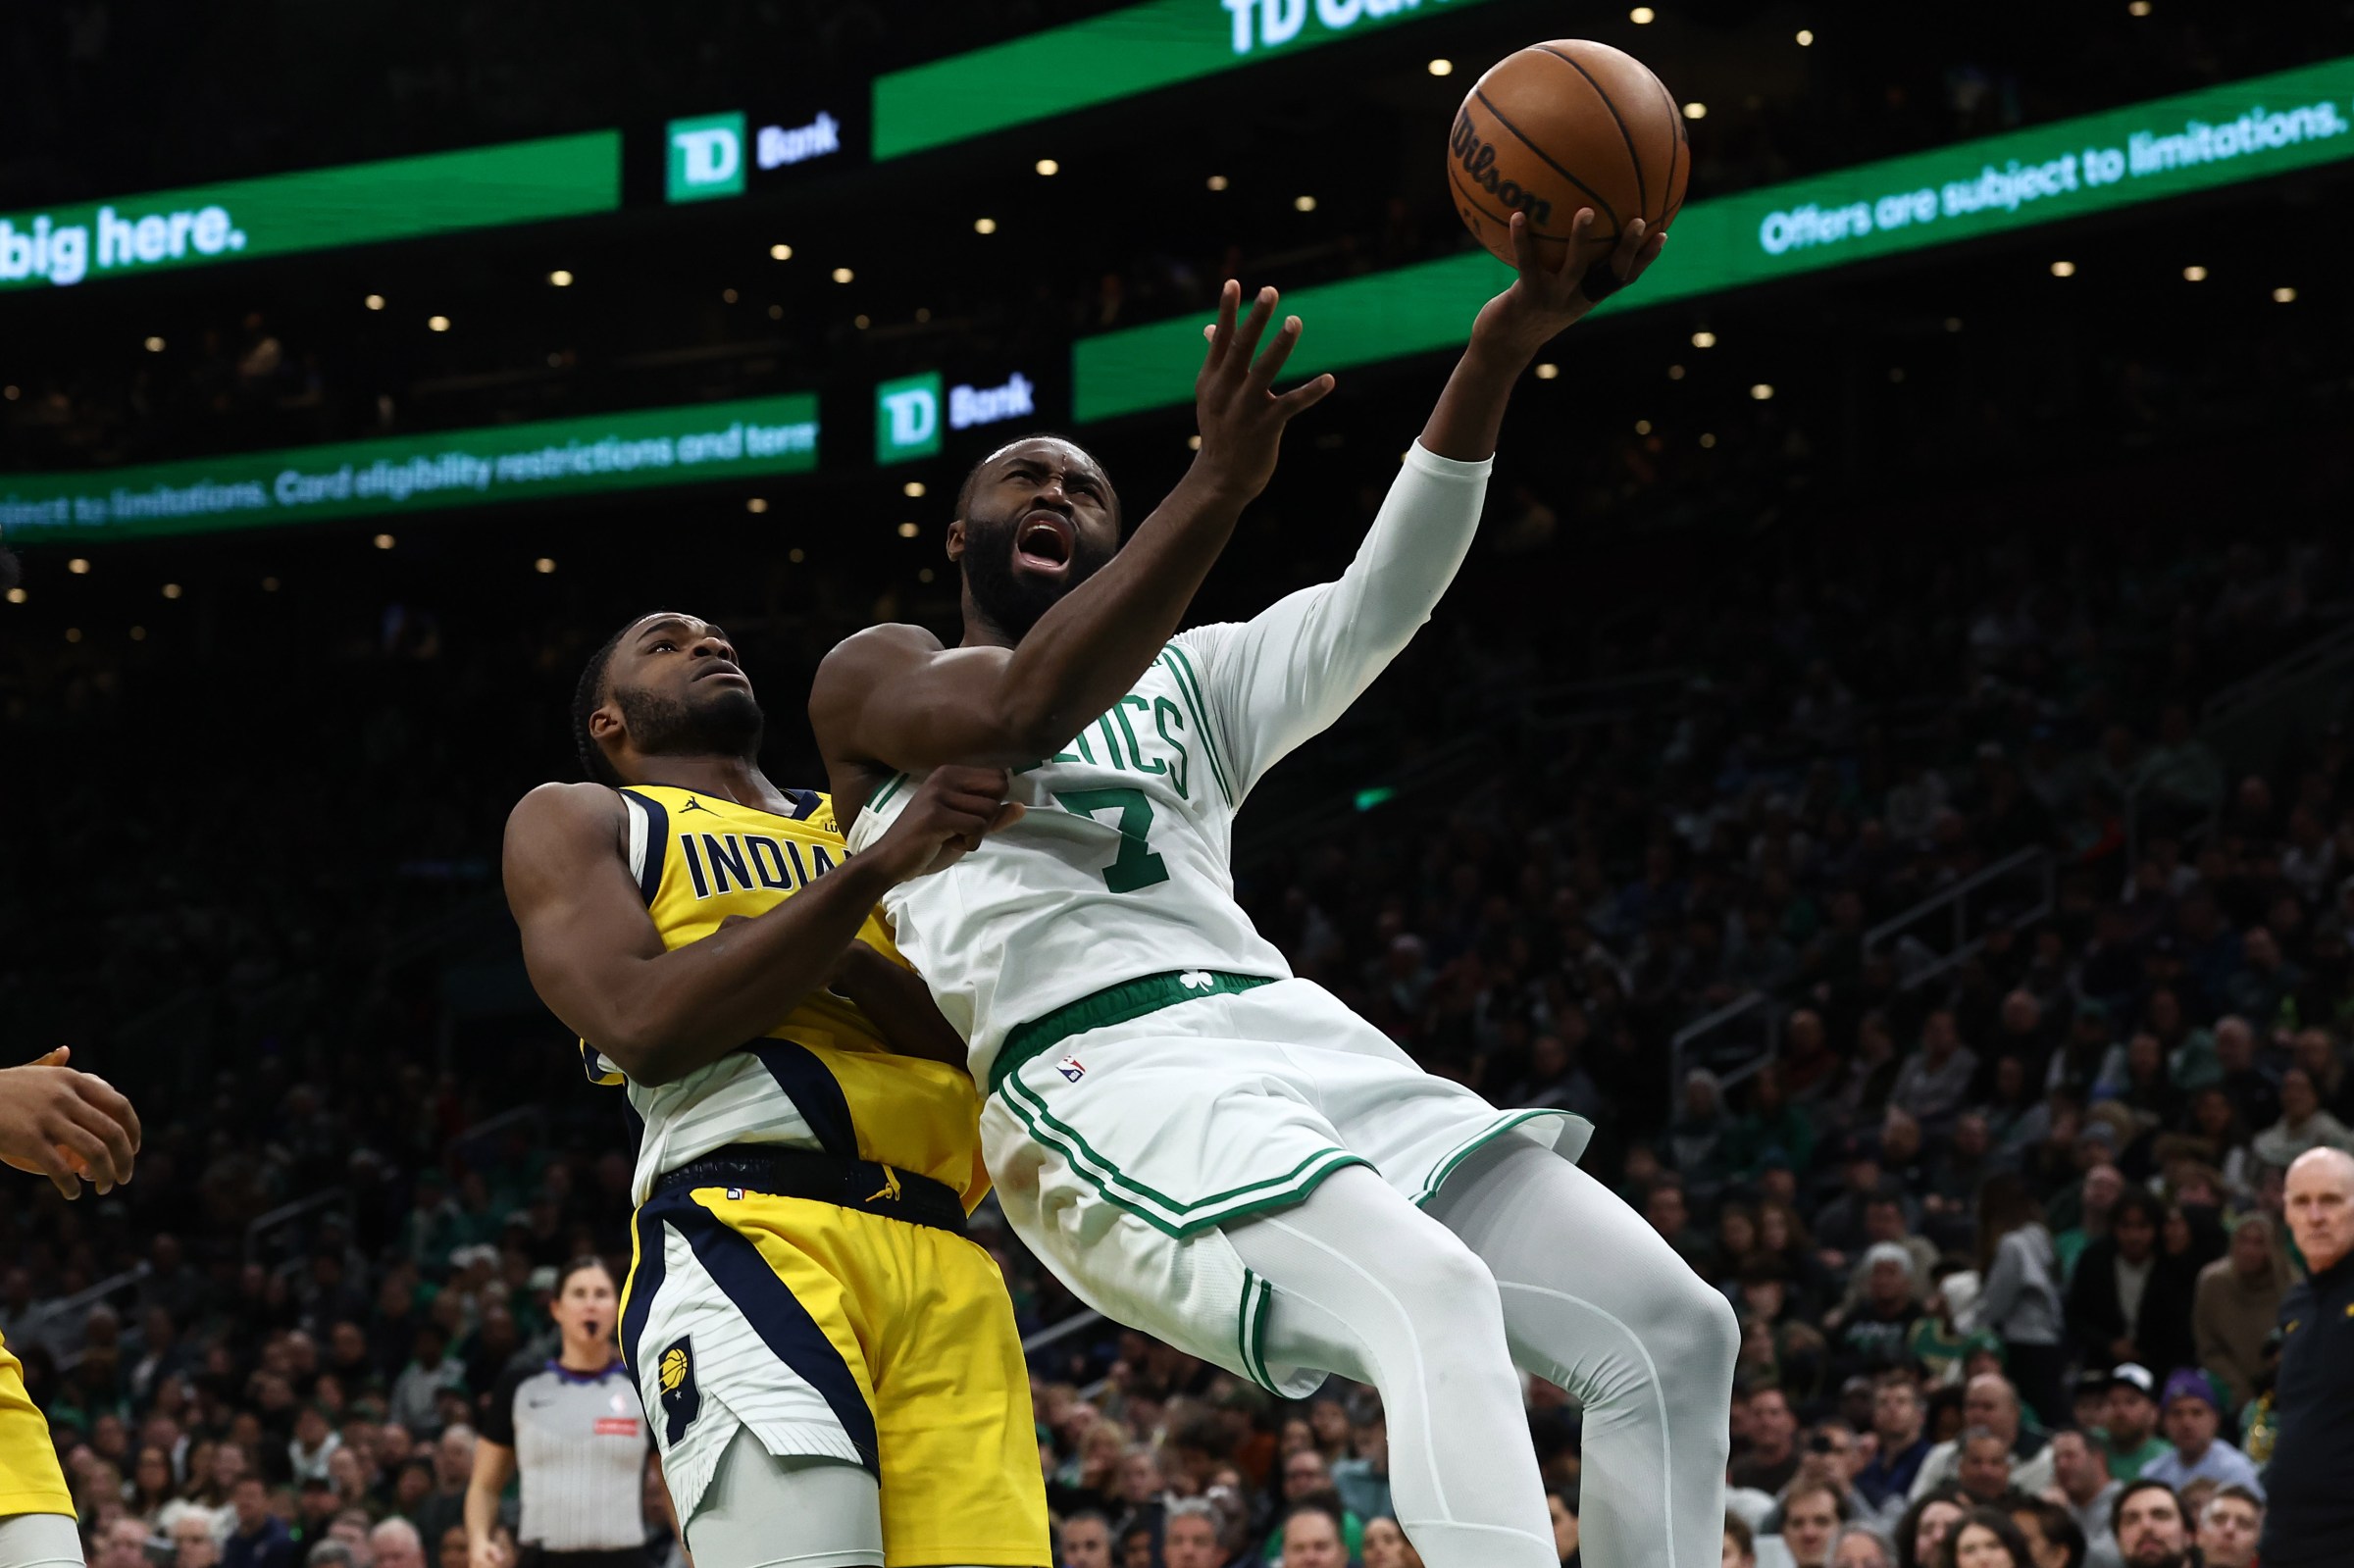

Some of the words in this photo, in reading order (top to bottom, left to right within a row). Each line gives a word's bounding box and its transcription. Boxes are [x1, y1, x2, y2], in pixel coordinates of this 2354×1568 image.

[1221, 0, 1308, 54] TD
[673, 127, 741, 184] TD
[756, 110, 841, 171] Bank
[1451, 106, 1552, 228] Wilson
[1760, 201, 1872, 255] Offers
[1874, 187, 1938, 230] are
[1941, 152, 2077, 218] subject
[2082, 145, 2125, 187] to
[2128, 101, 2348, 177] limitations.
[0, 214, 88, 286] big
[97, 206, 246, 269] here.
[880, 389, 936, 446] TD
[948, 371, 1036, 430] Bank
[275, 464, 353, 507] Card
[355, 452, 491, 502] eligibility
[495, 434, 675, 483] restrictions
[677, 422, 742, 465] and
[678, 832, 853, 901] INDIA
[1051, 787, 1170, 894] 7
